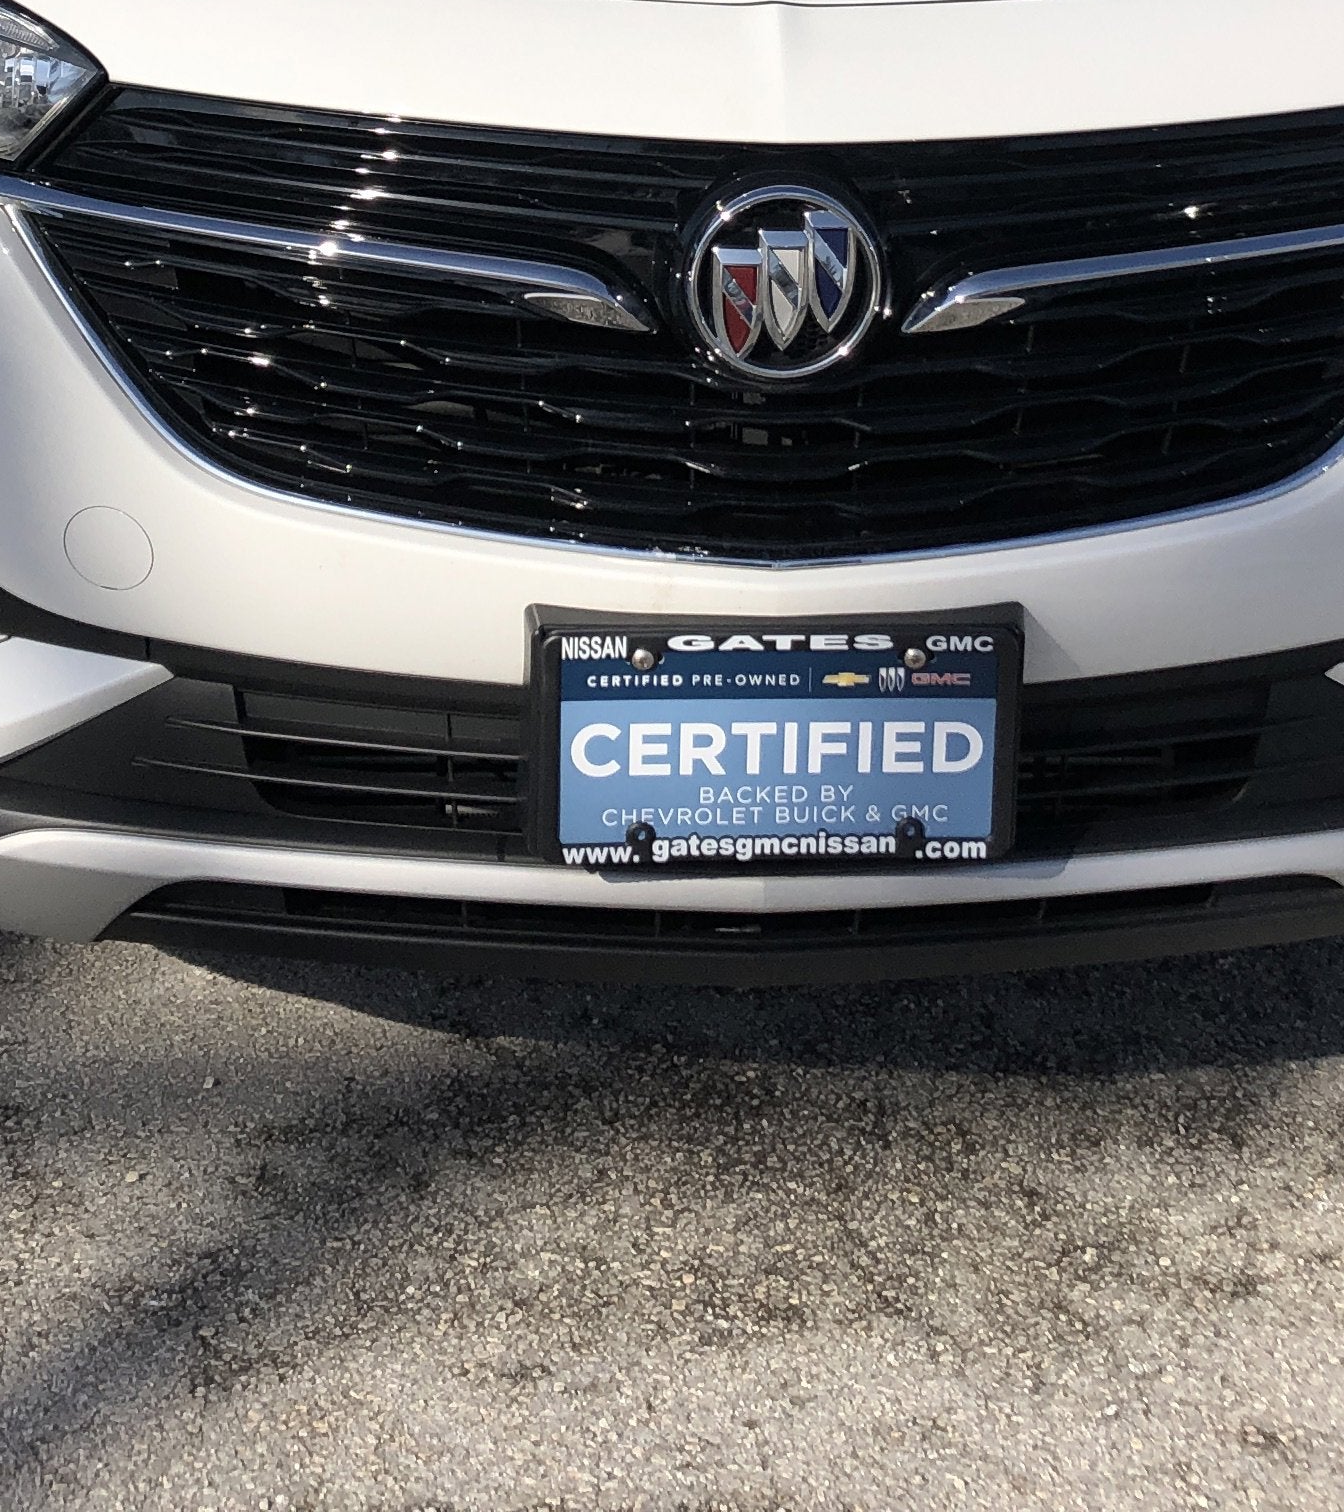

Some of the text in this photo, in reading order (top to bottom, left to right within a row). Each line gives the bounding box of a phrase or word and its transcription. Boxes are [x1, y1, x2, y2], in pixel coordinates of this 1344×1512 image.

[561, 634, 994, 660] NISSAN GATES GMC
[586, 673, 801, 688] CERTIFIED PRE-OWNED
[911, 672, 971, 686] GMC
[569, 720, 984, 777] CERTIFIED
[699, 784, 854, 804] BACKED BY
[602, 804, 949, 826] CHEVROLET BUICK & GMC
